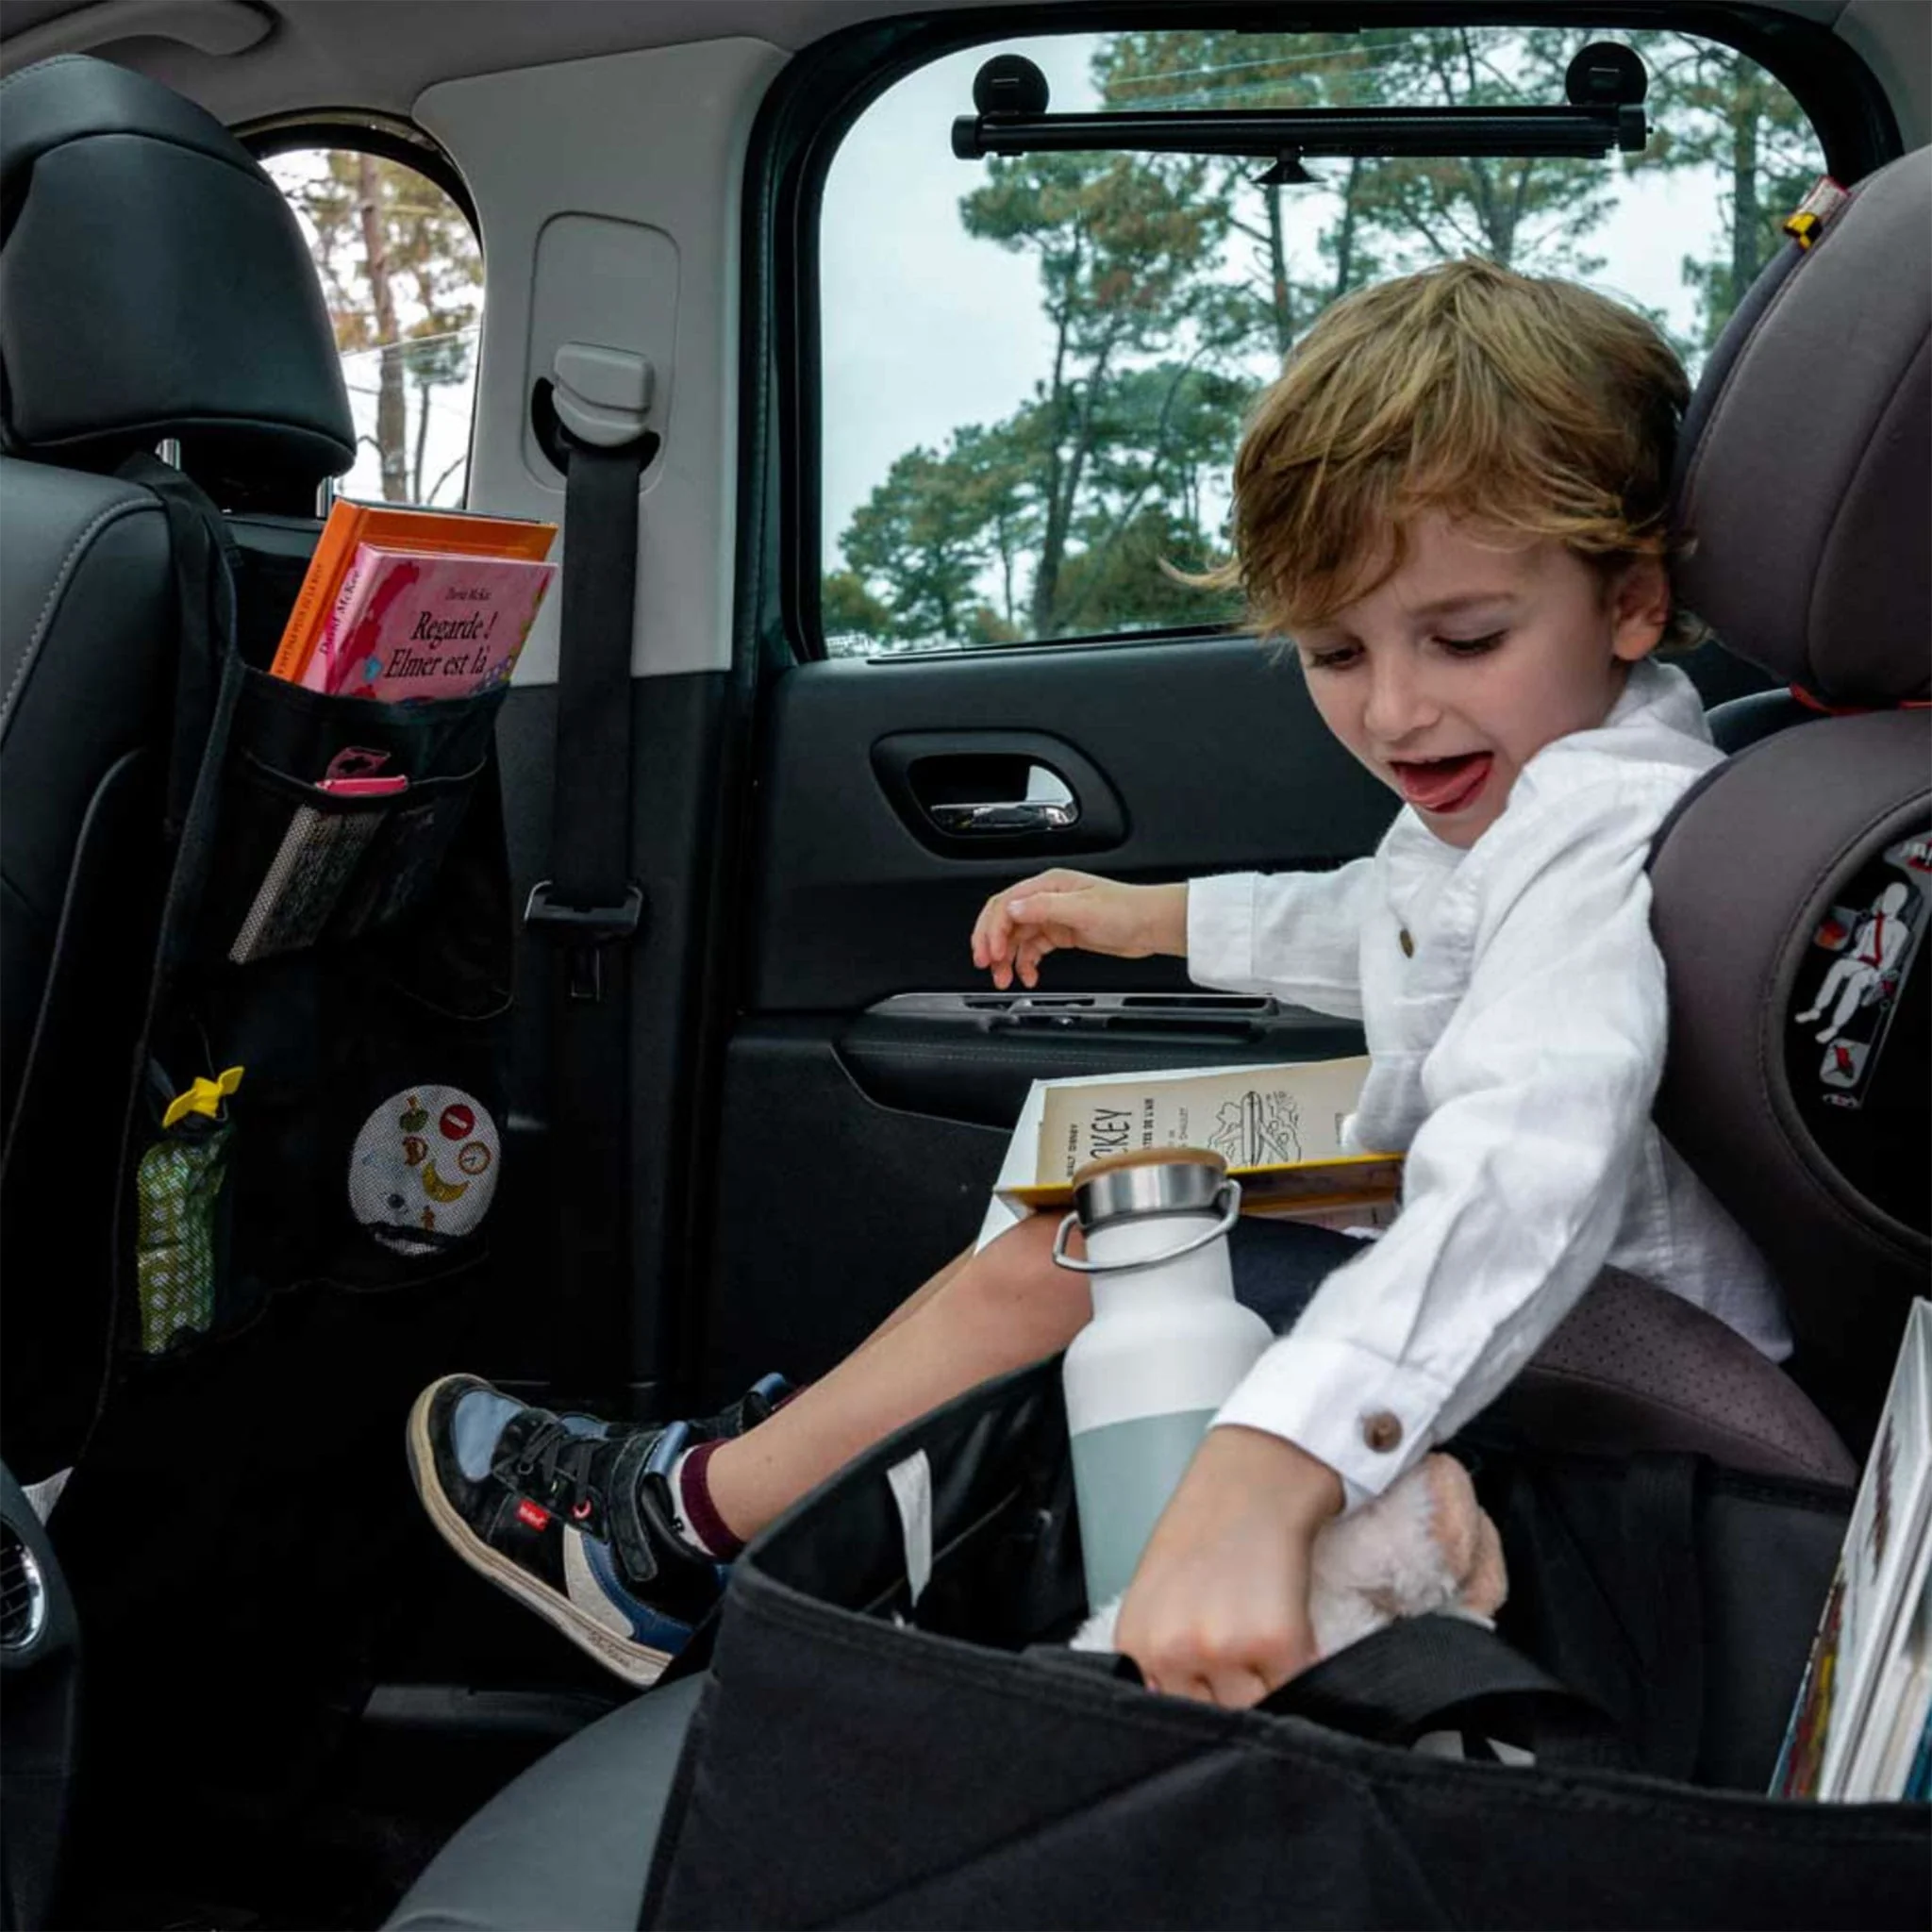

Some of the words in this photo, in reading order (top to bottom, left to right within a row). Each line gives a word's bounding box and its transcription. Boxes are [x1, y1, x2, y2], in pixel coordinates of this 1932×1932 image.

[319, 615, 341, 656] David
[337, 569, 362, 615] McKee
[408, 609, 484, 651] Regarde
[382, 647, 443, 678] Elmer
[441, 653, 470, 676] est
[468, 644, 491, 675] là
[1068, 1123, 1078, 1152] DISNEY
[1066, 1154, 1076, 1178] WALT
